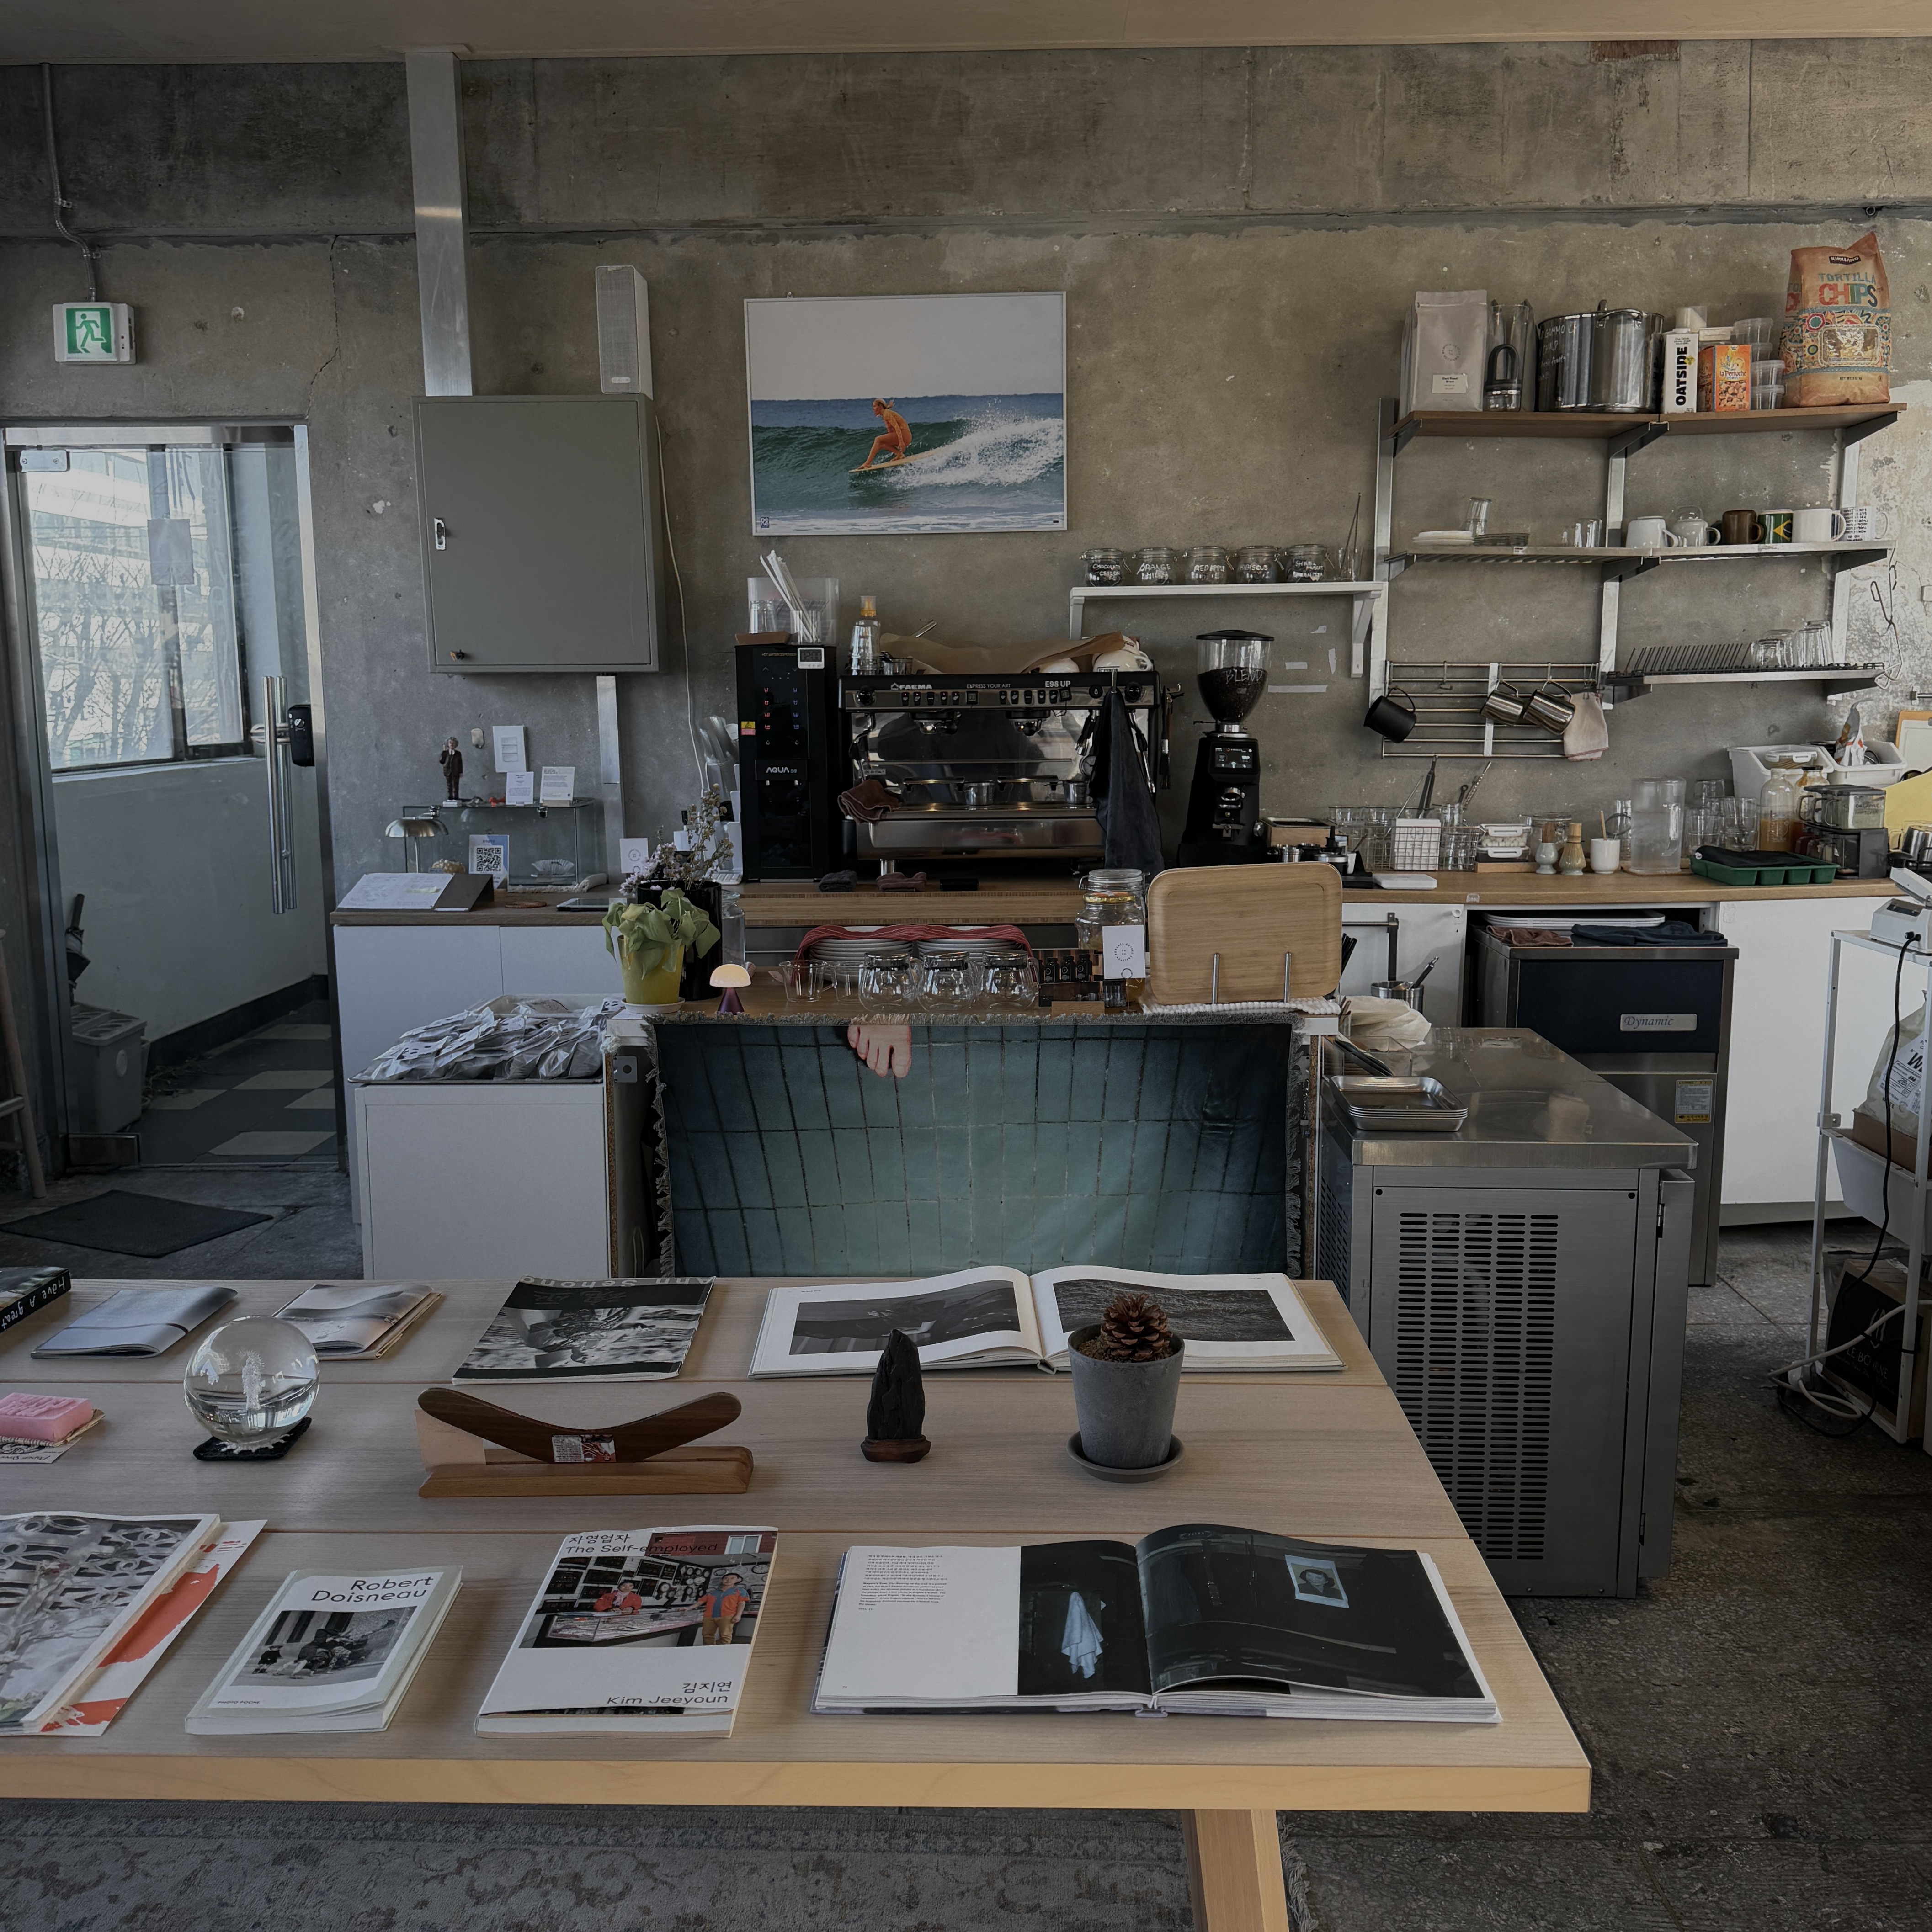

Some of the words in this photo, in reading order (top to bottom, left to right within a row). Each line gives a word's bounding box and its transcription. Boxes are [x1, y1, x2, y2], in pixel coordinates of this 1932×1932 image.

[1818, 272, 1876, 285] TORTILLA
[1819, 283, 1878, 308] CHIPS
[1676, 347, 1687, 406] OATSIDE
[1137, 563, 1171, 574] ORANGE
[1224, 669, 1263, 684] BLEND
[1624, 1016, 1674, 1029] Dynamic
[42, 1276, 65, 1299] have
[29, 1295, 36, 1307] A
[1, 1301, 23, 1329] great
[1847, 1348, 1856, 1359] LE
[568, 1533, 631, 1545] 자영업자
[601, 1543, 717, 1555] Self-employed
[351, 1576, 434, 1590] Robert
[311, 1589, 426, 1603] Doisneau
[681, 1681, 732, 1693] 김지연
[649, 1696, 728, 1705] Jeeyoun
